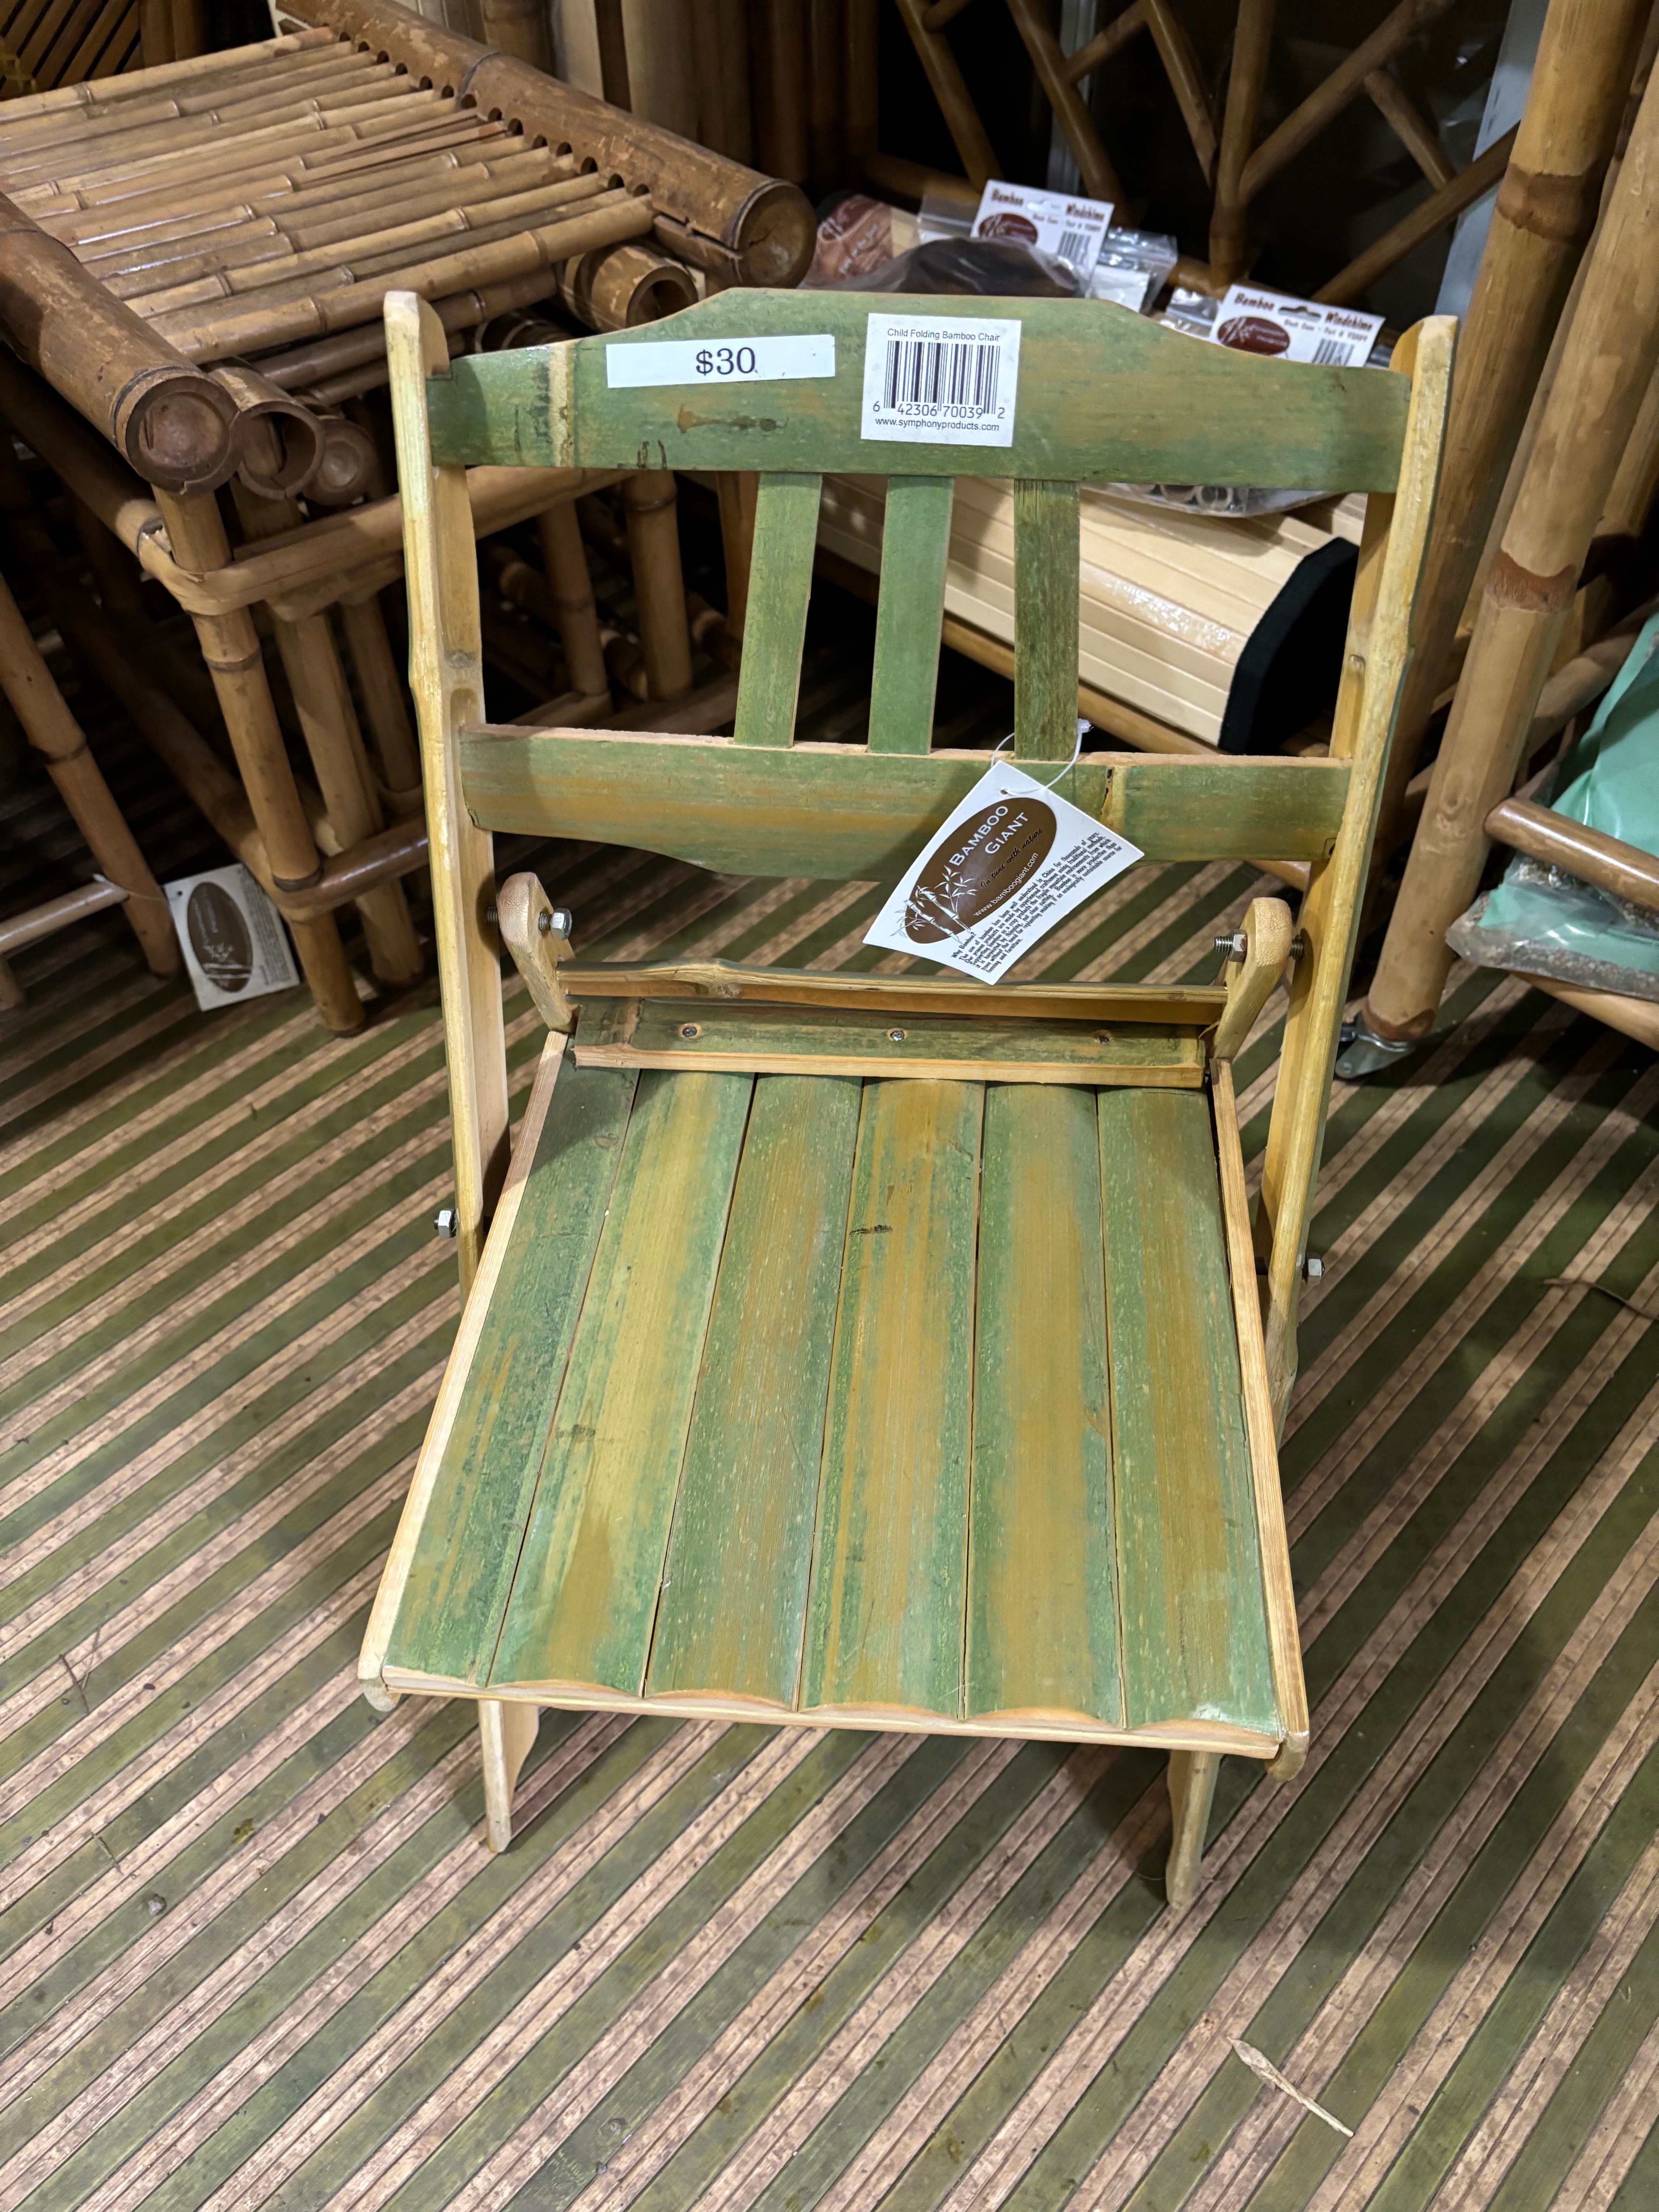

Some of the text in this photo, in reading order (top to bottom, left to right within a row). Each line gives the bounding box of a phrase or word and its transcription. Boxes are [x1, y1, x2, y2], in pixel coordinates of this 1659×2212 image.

[888, 328, 1000, 341] Child Folding Bamboo Chair
[696, 347, 755, 376] $30
[873, 401, 1005, 419] 6 42306 70039 2
[875, 417, 1000, 431] www.symphonyproducts.com
[950, 806, 1007, 865] BAMBOO
[985, 813, 1027, 853] GIANT
[974, 854, 1037, 915] www.bamboogiant.com
[959, 932, 976, 949] Bamboo?
